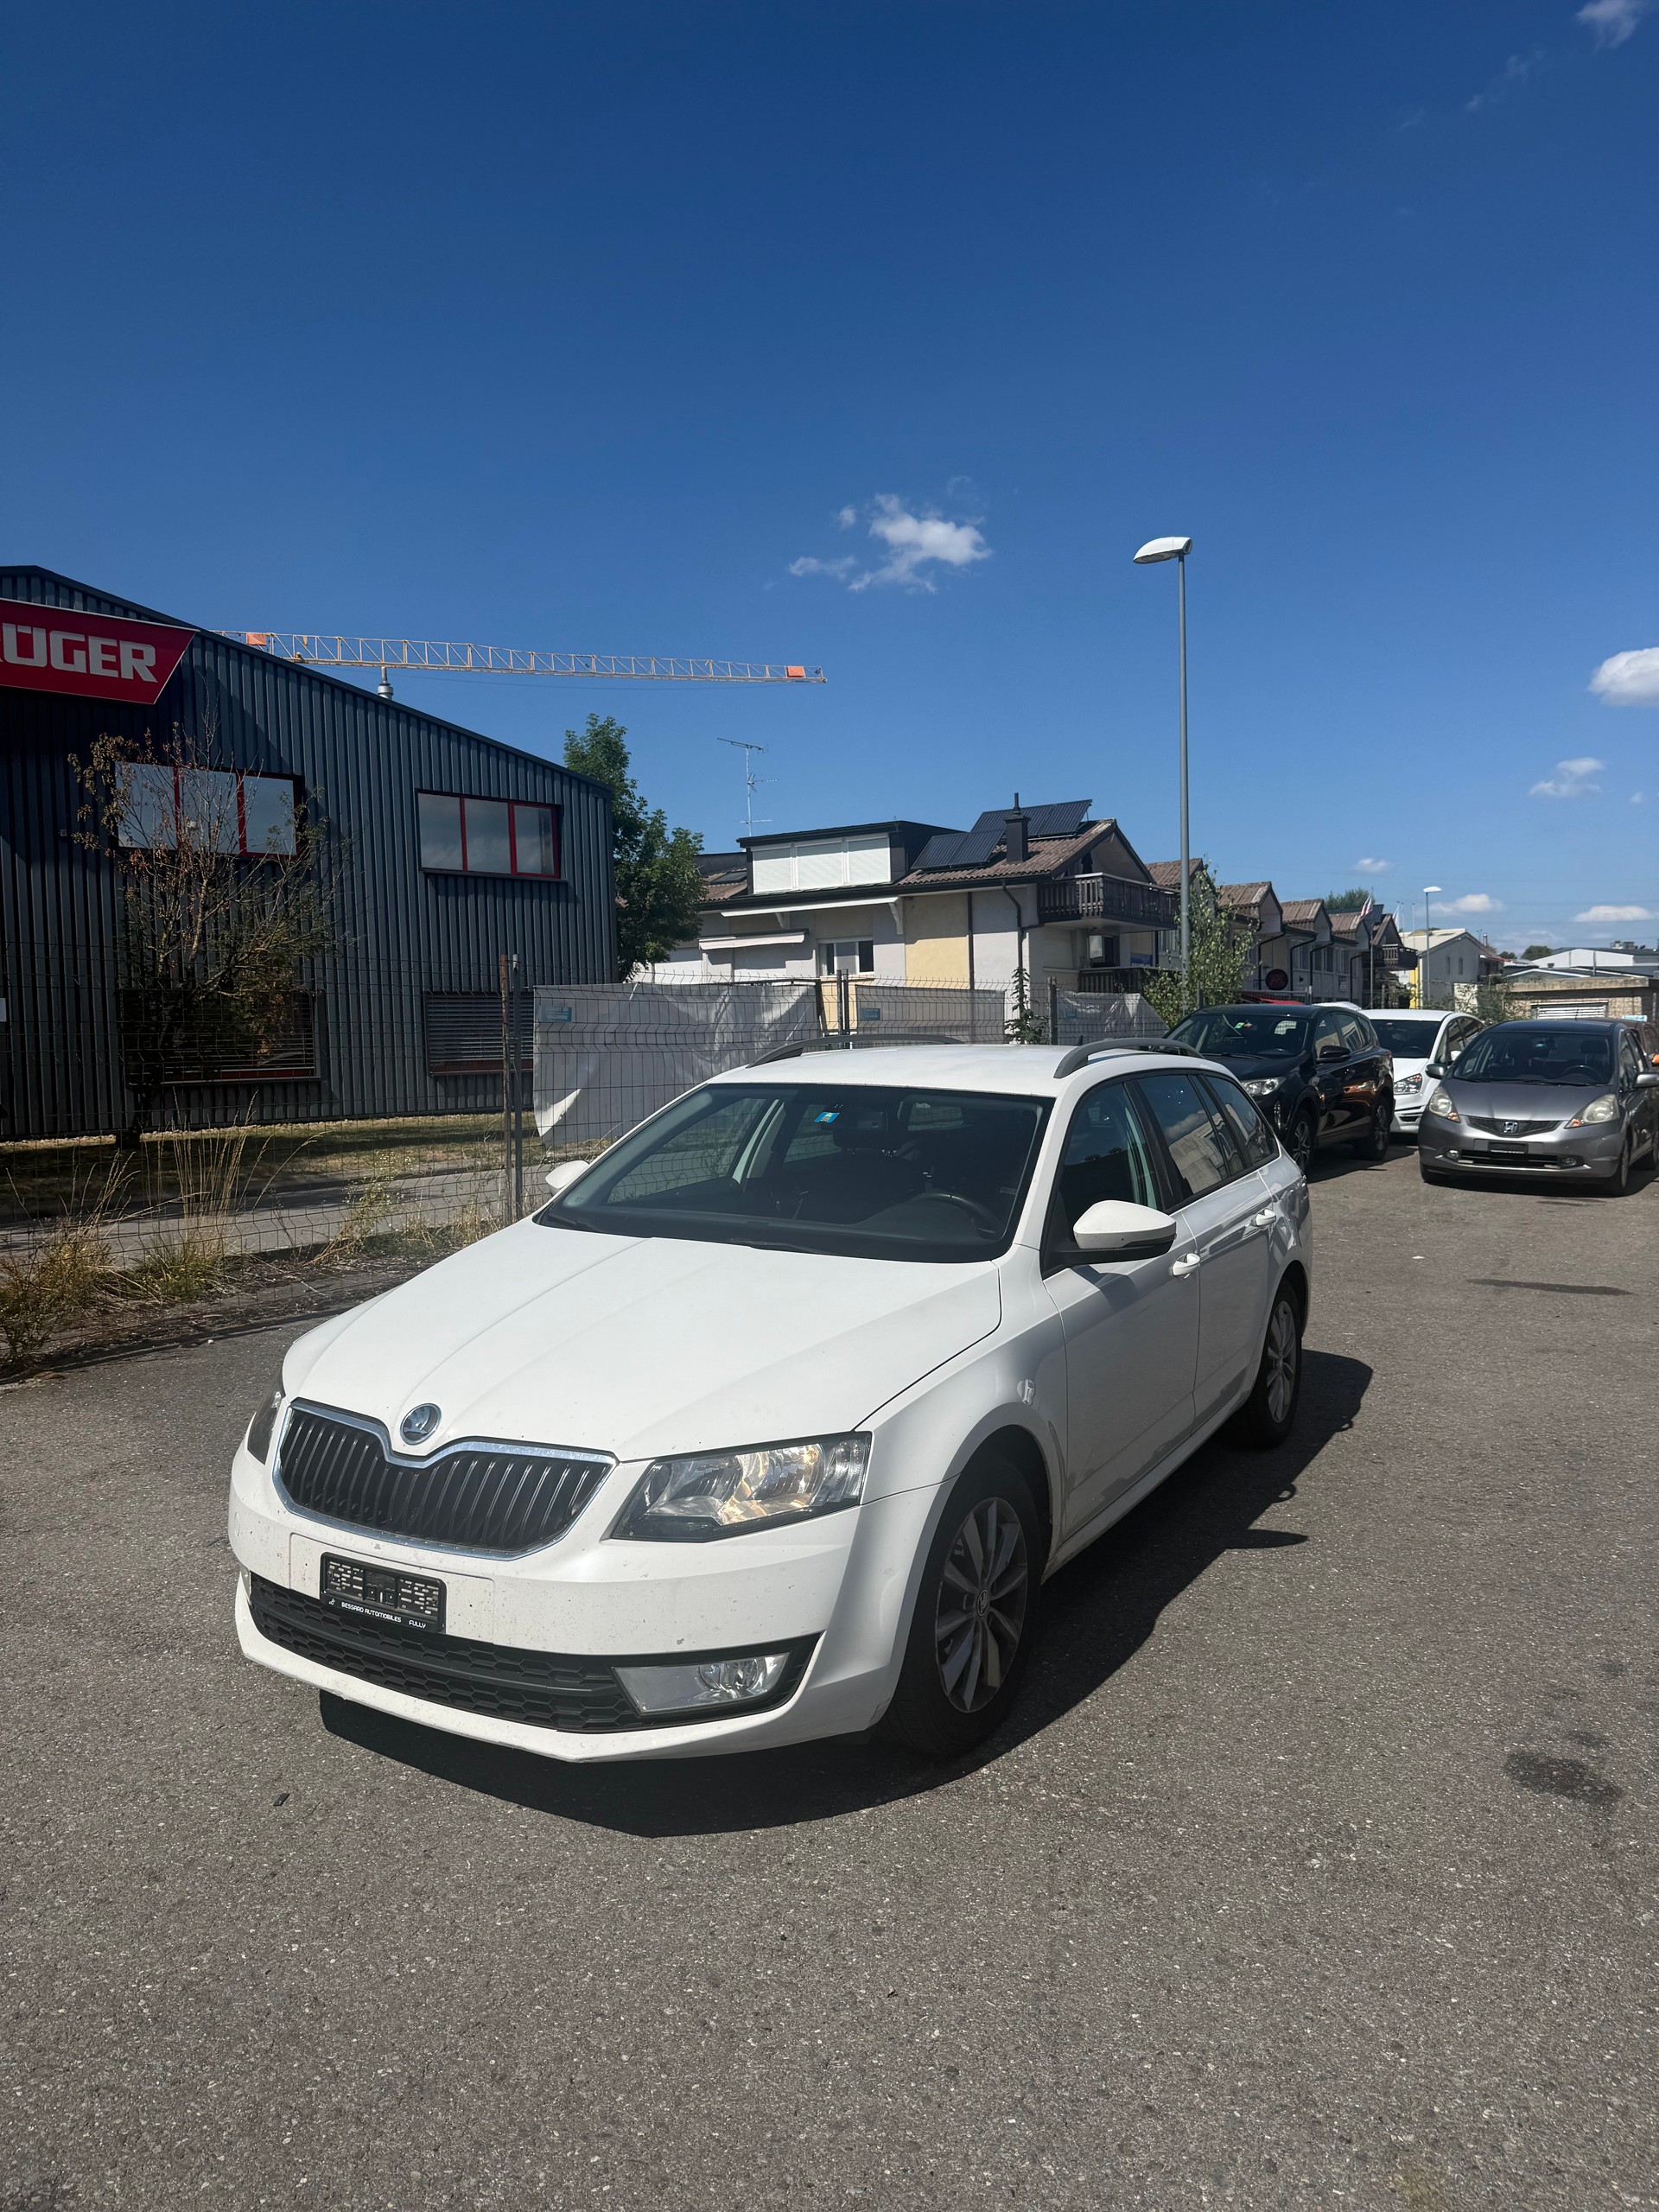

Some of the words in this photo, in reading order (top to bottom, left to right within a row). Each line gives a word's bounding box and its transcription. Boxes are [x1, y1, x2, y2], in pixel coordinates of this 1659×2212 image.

[0, 622, 158, 683] ÜGER
[365, 1608, 402, 1623] AUTOMOBILES
[409, 1619, 427, 1629] FULLY
